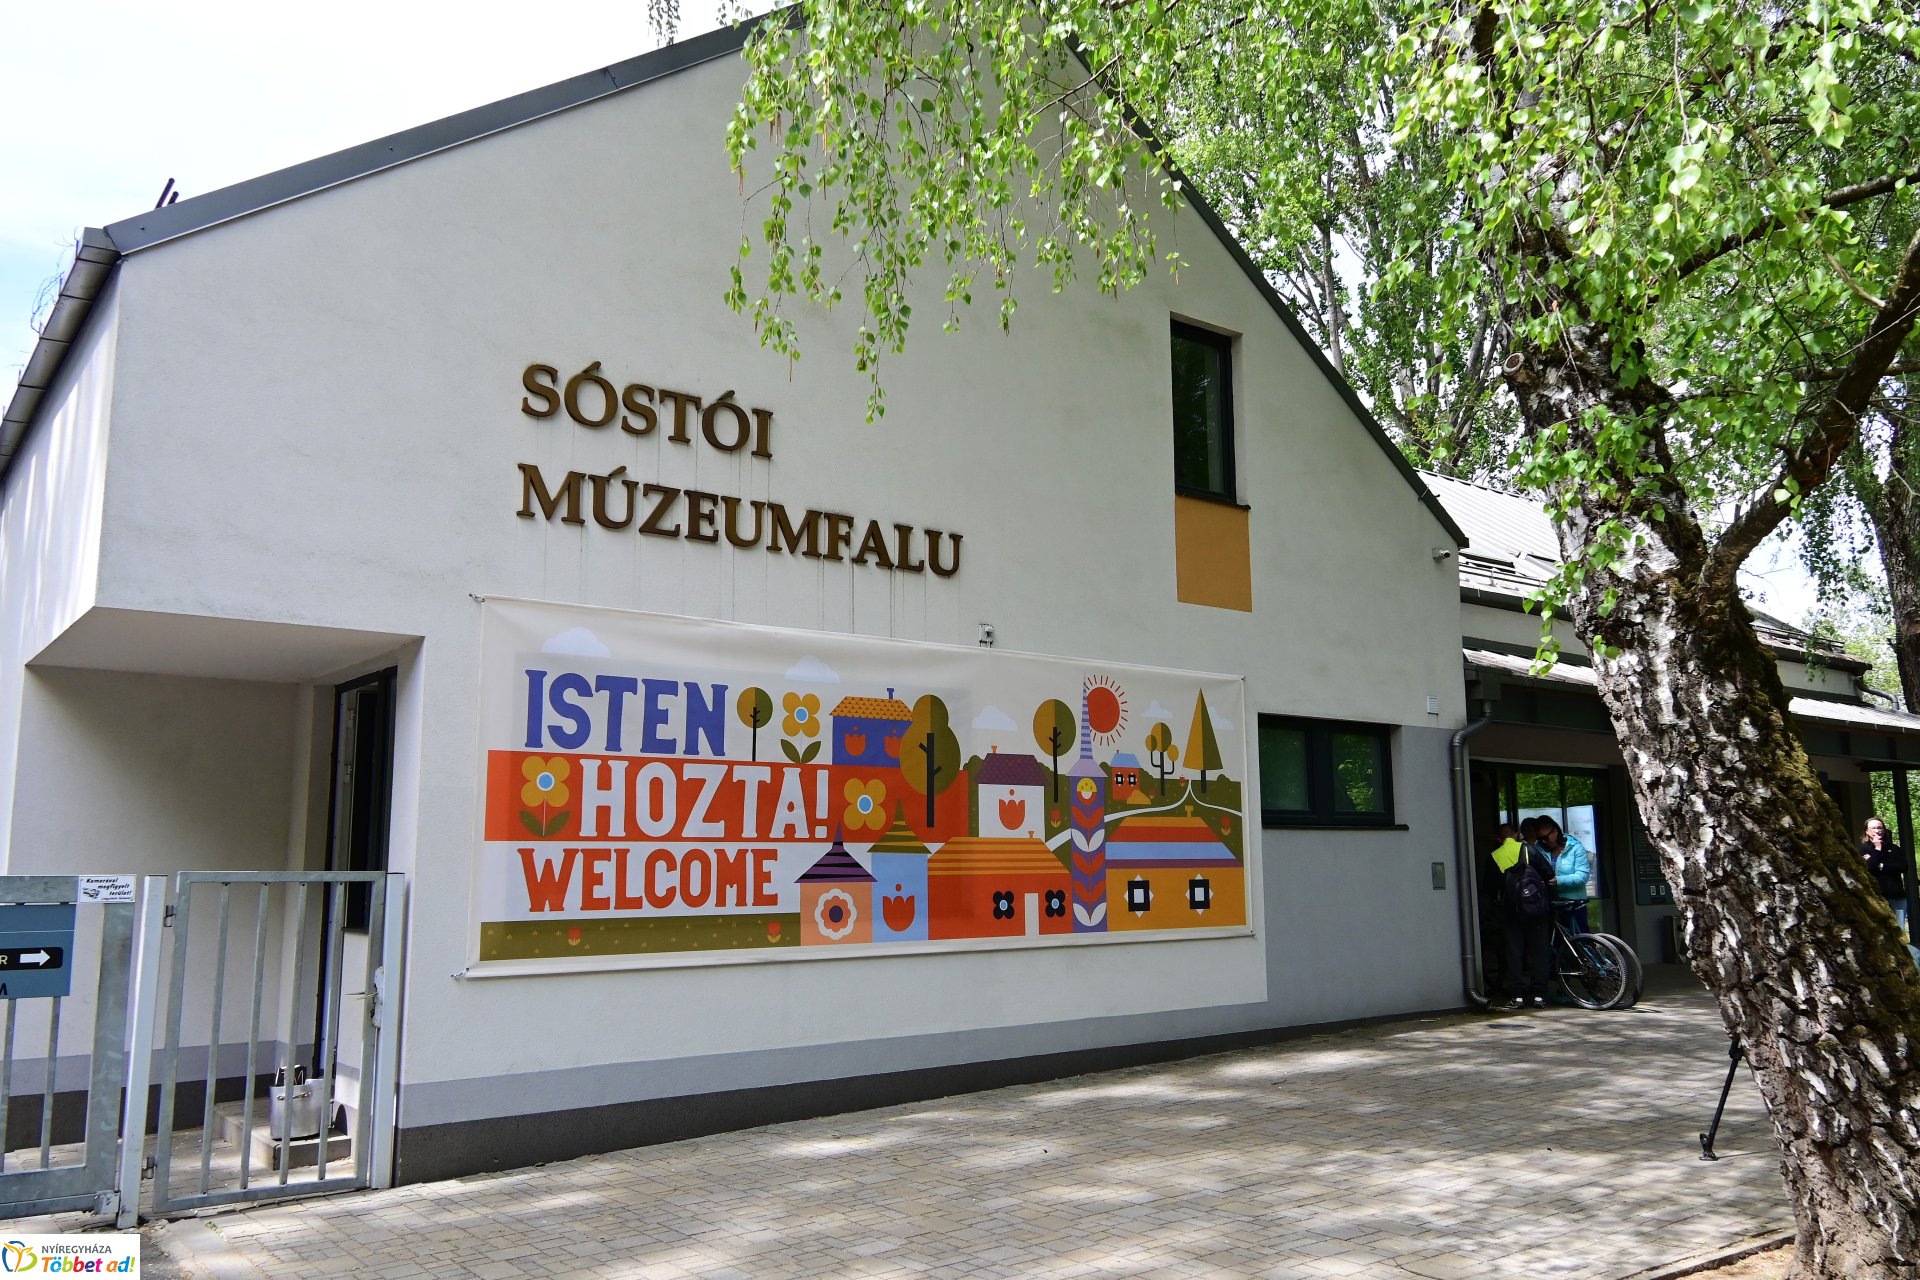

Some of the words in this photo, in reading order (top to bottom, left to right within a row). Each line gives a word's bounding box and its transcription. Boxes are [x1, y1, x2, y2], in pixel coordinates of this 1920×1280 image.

[521, 361, 773, 459] SÓSTÓI
[516, 463, 964, 577] MÚZEUMFALU
[524, 669, 729, 757] ISTEN
[578, 758, 829, 839] HOZTA!
[517, 848, 779, 913] WELCOME
